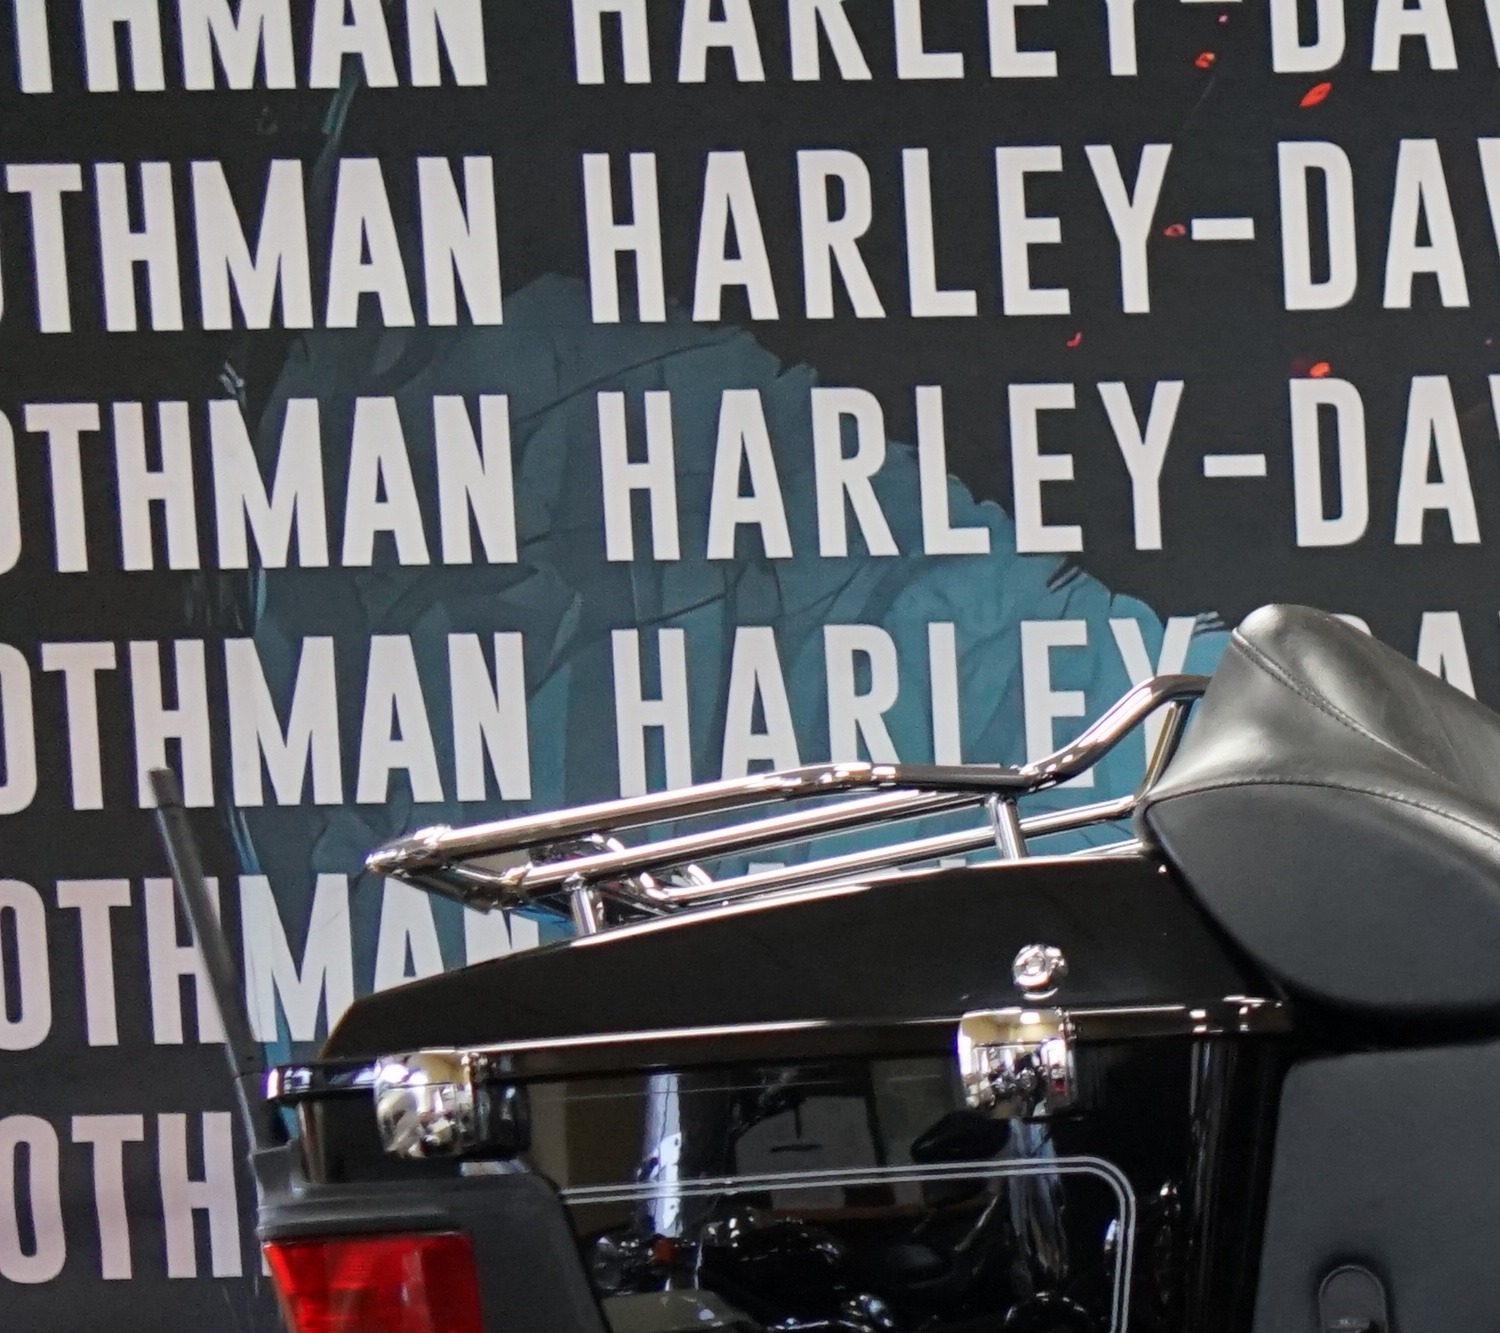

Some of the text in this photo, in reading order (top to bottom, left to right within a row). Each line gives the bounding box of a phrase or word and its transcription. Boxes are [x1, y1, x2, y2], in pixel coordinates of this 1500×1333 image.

[0, 155, 504, 334] THMAN
[0, 394, 519, 576] THMAN
[0, 873, 540, 1051] OTHMA
